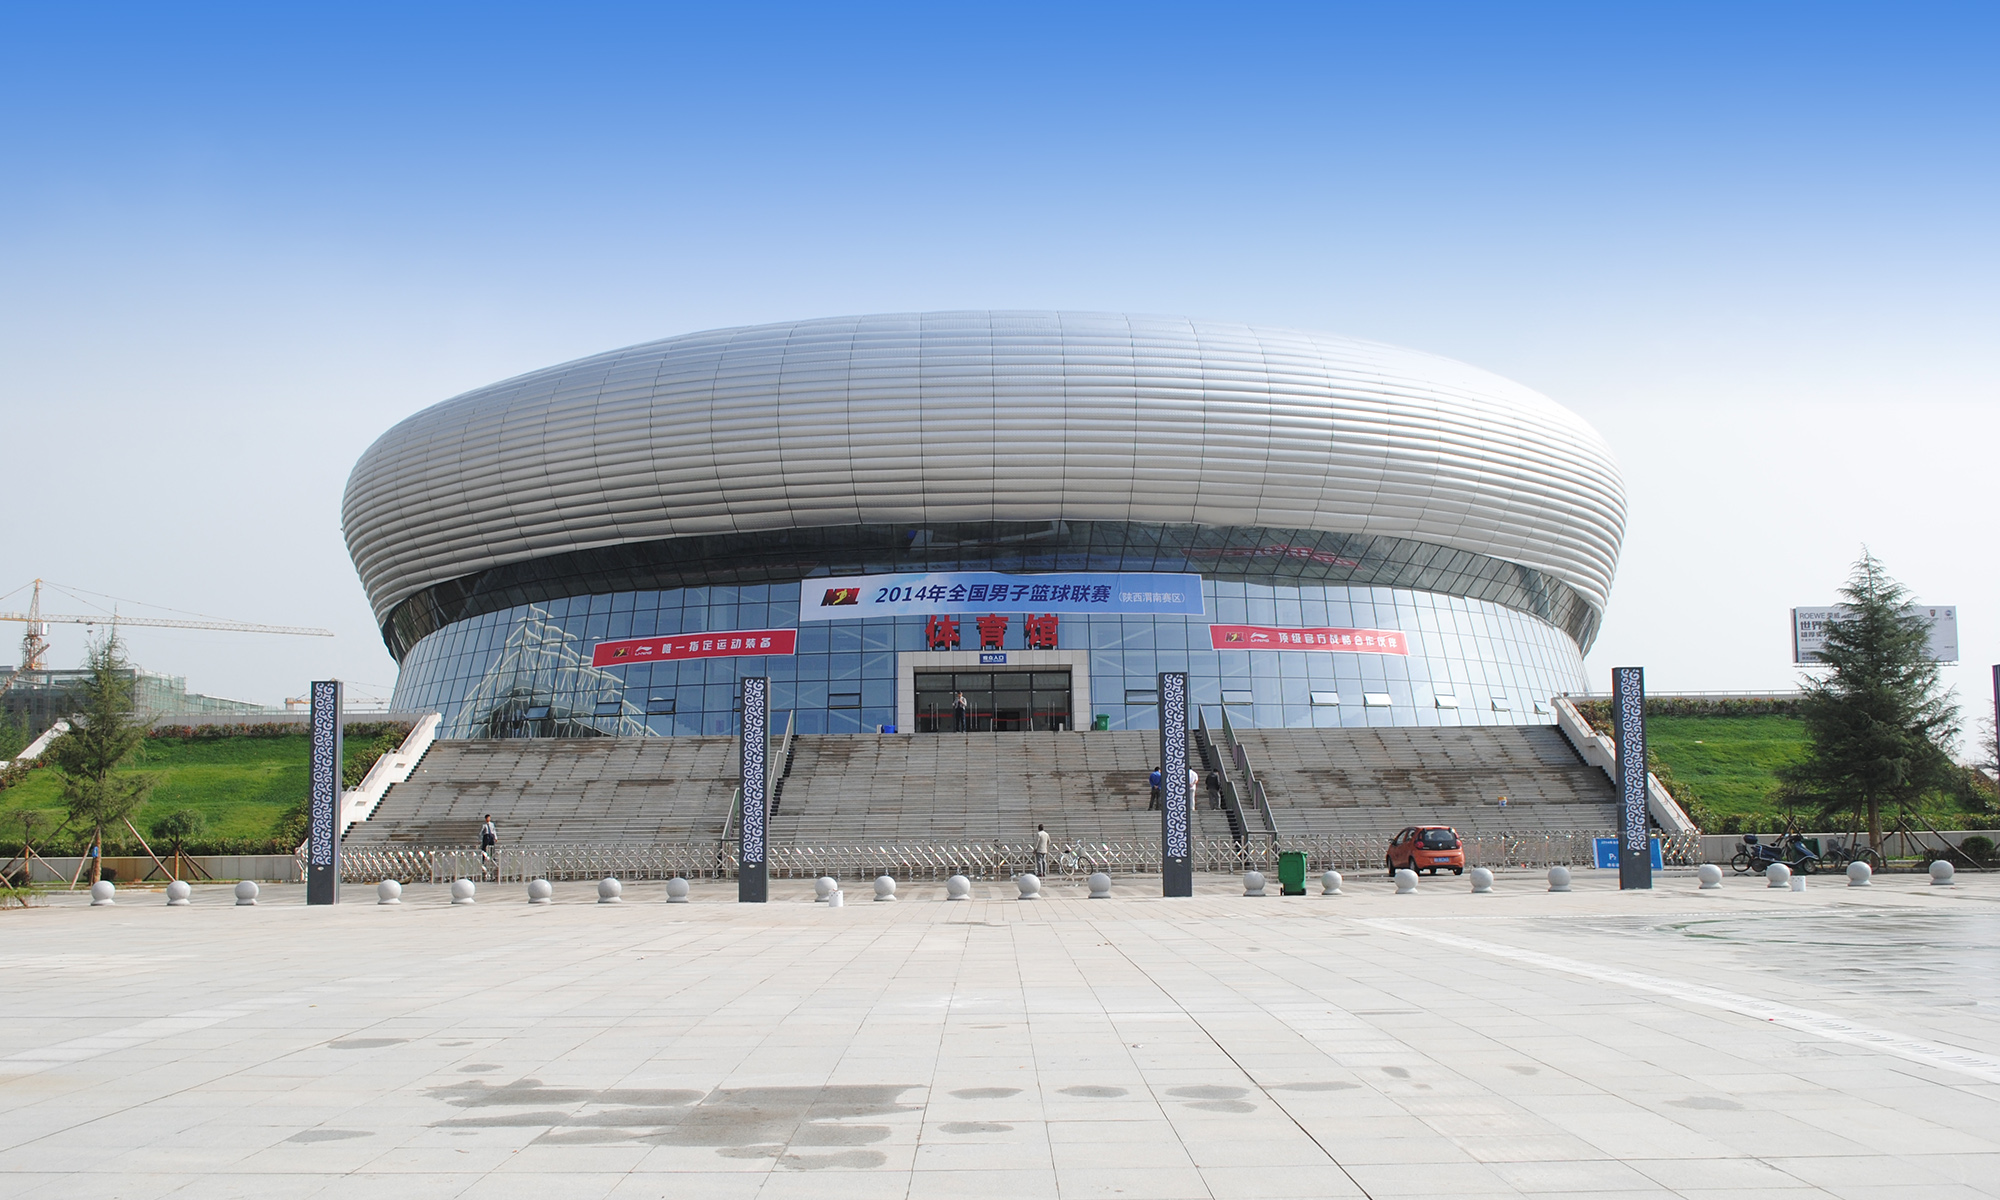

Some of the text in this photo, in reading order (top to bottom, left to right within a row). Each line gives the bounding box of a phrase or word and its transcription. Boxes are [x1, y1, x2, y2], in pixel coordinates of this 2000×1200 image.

[875, 584, 1112, 603] 2014年全国男子篮球联赛
[925, 613, 1058, 648] 体育馆
[662, 637, 772, 654] 唯一指定运动装备
[1278, 632, 1398, 648] 顶级官方战略合作伙伴
